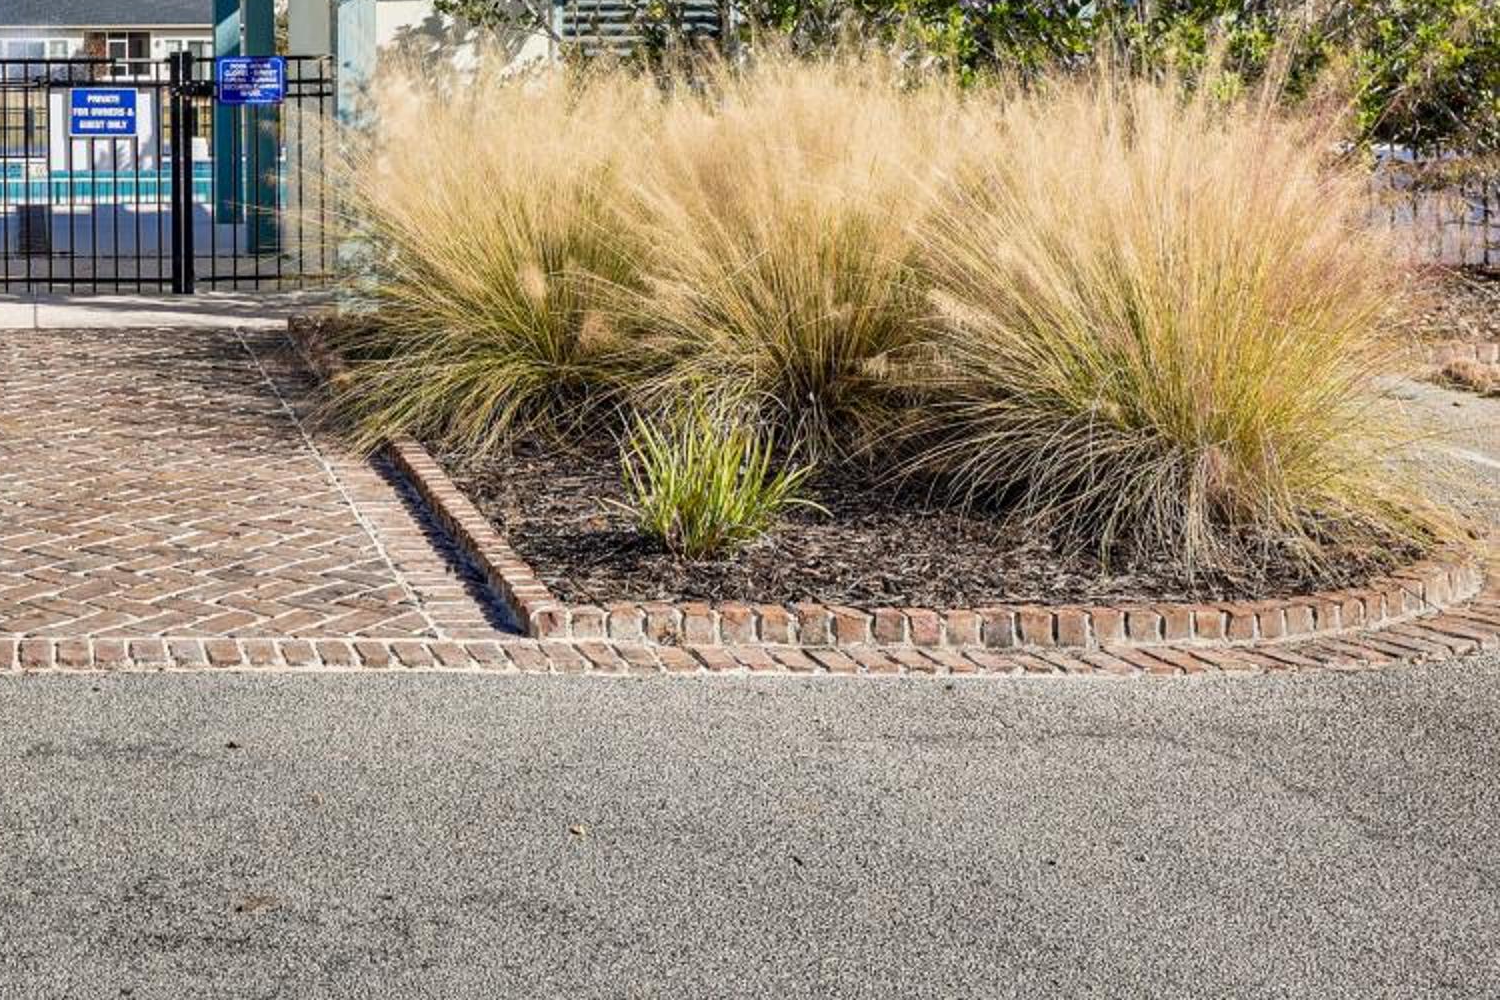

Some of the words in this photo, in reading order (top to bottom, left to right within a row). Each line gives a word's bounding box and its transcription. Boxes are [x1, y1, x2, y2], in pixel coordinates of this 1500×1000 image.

[87, 94, 120, 104] PRIVATE
[73, 107, 89, 117] FOR
[90, 107, 125, 117] OWNERS
[106, 120, 127, 129] ONLY
